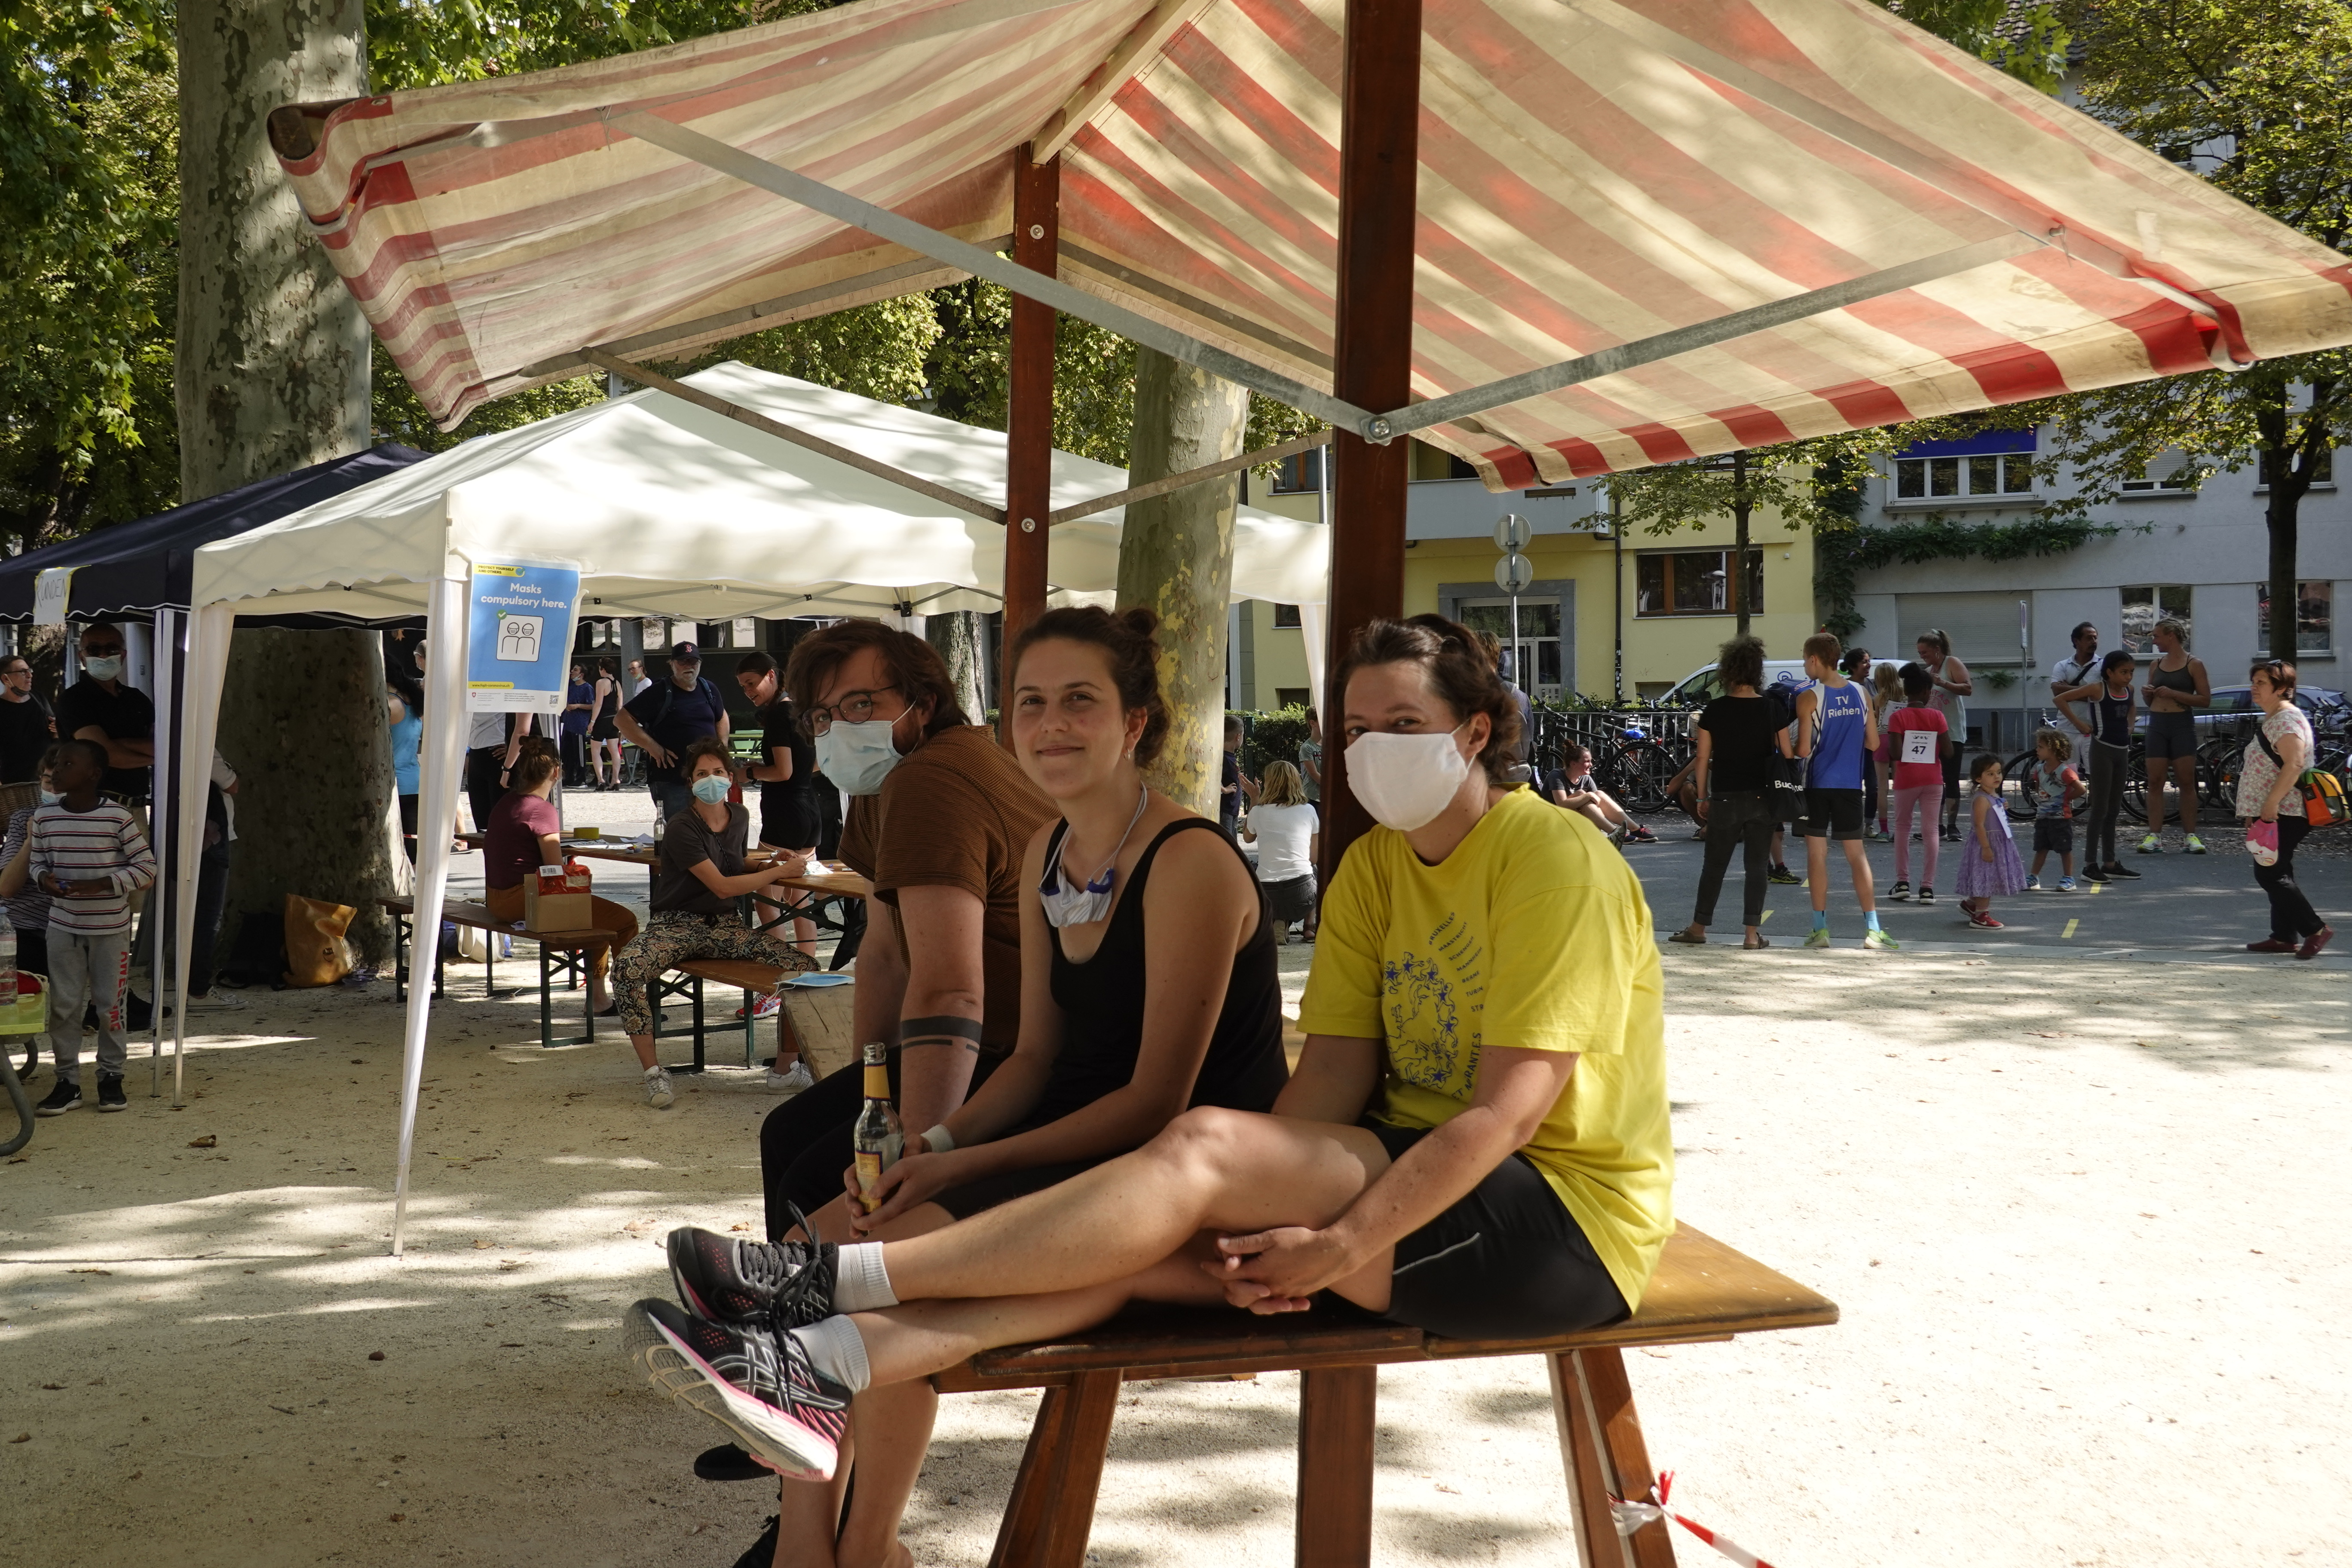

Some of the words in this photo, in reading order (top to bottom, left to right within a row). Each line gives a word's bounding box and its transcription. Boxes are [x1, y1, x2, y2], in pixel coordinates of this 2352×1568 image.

[510, 583, 542, 594] Masks
[481, 595, 540, 608] compulsory
[542, 598, 567, 608] here.
[1835, 695, 1849, 705] TV
[1828, 707, 1860, 718] Riehen
[1911, 746, 1926, 754] 47
[1429, 912, 1455, 945] BRUXELLES
[1438, 921, 1467, 952] MAASTRICHT
[1449, 936, 1474, 961] SCHENGEN
[1456, 946, 1482, 971] MANNHEIM
[1462, 970, 1480, 983] BERNE
[1466, 986, 1483, 997] TURIN
